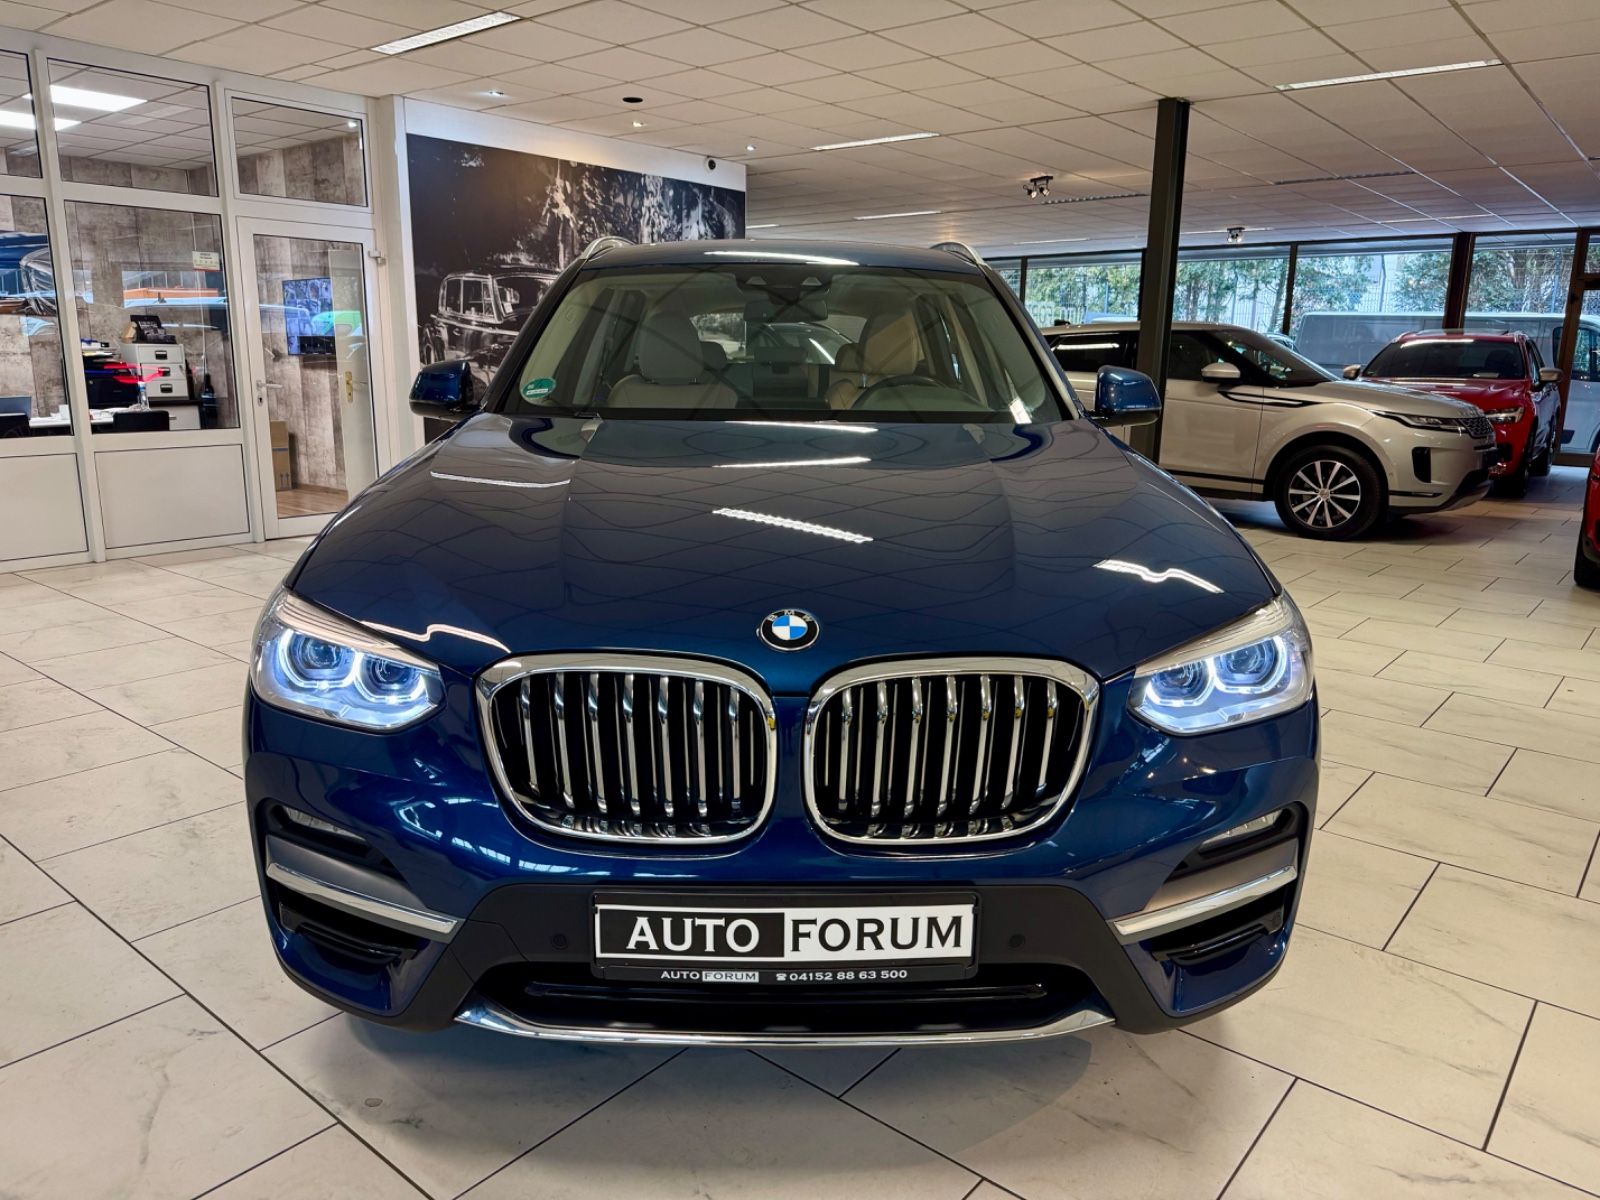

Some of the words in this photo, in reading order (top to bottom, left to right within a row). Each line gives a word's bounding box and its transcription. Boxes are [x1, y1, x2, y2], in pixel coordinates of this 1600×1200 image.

[626, 916, 759, 952] AUTO
[791, 916, 962, 952] FORUM
[660, 971, 700, 980] AUTO
[704, 972, 757, 981] FORUM
[789, 972, 833, 981] 04152
[836, 971, 856, 980] 88
[858, 971, 877, 980] 63
[880, 969, 908, 979] 500
